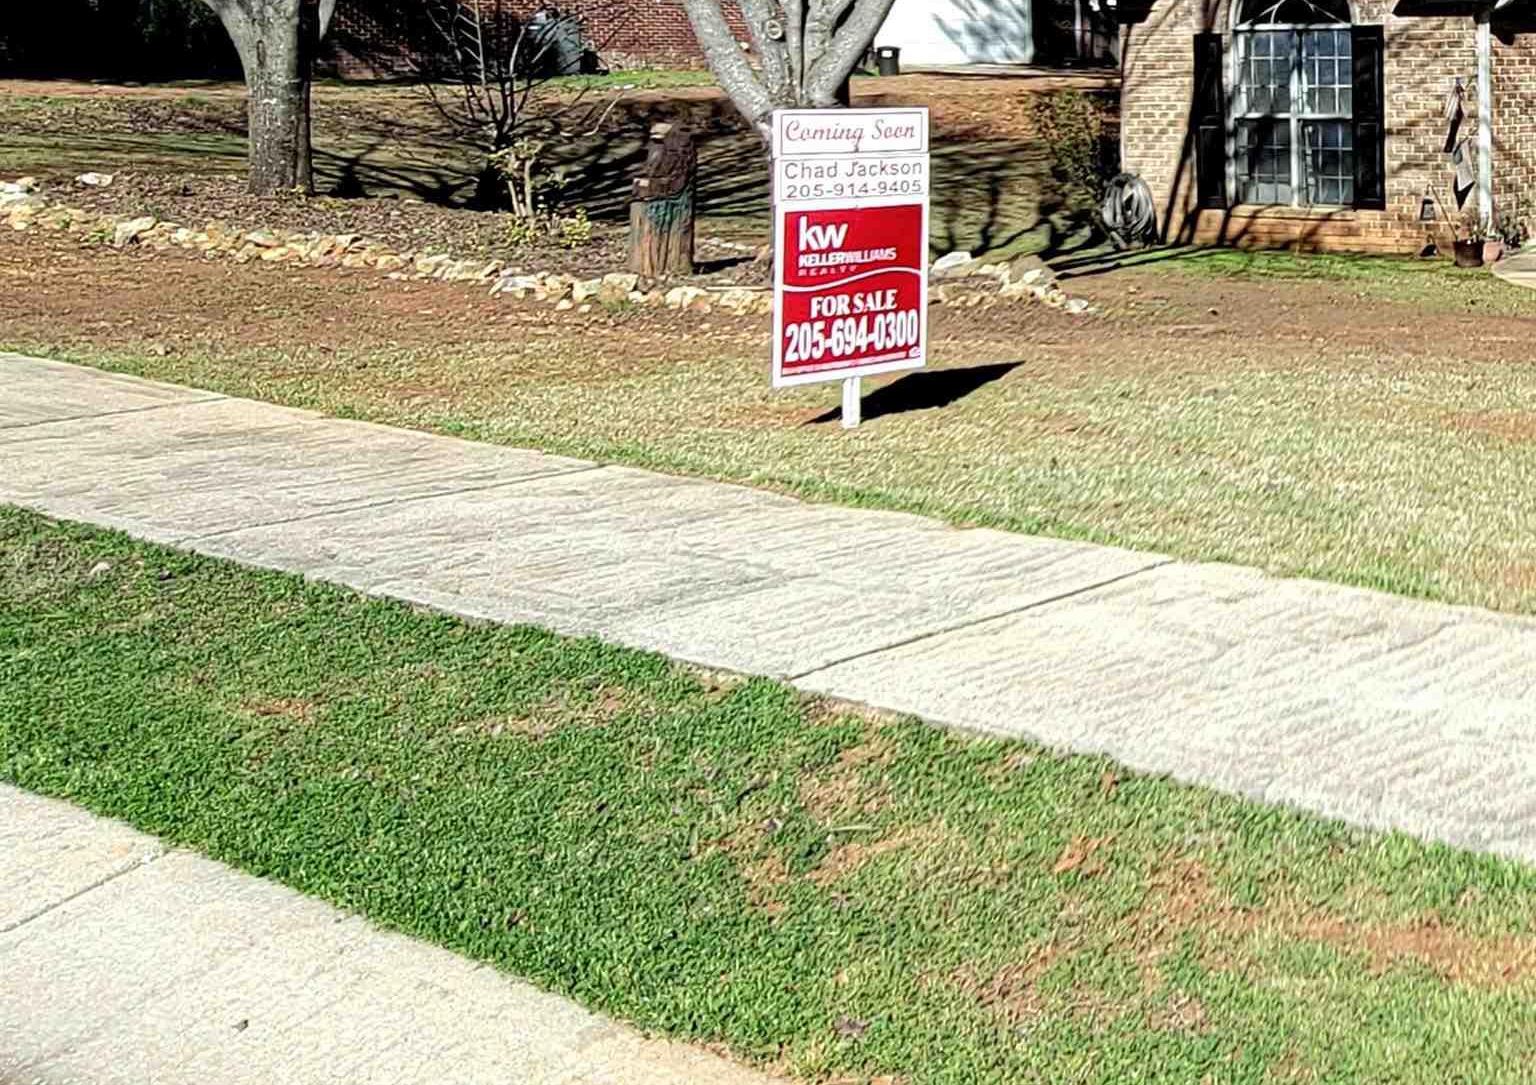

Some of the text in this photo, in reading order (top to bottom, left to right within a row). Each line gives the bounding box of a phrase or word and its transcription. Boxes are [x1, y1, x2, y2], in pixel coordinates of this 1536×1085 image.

[785, 119, 915, 148] Coming Soon
[784, 159, 922, 180] Chad Jackson
[786, 179, 922, 199] 205-914-9405
[798, 215, 849, 252] kw
[798, 265, 858, 277] REALTY
[810, 289, 898, 319] FOR SALE
[784, 309, 919, 363] 205-694-0300
